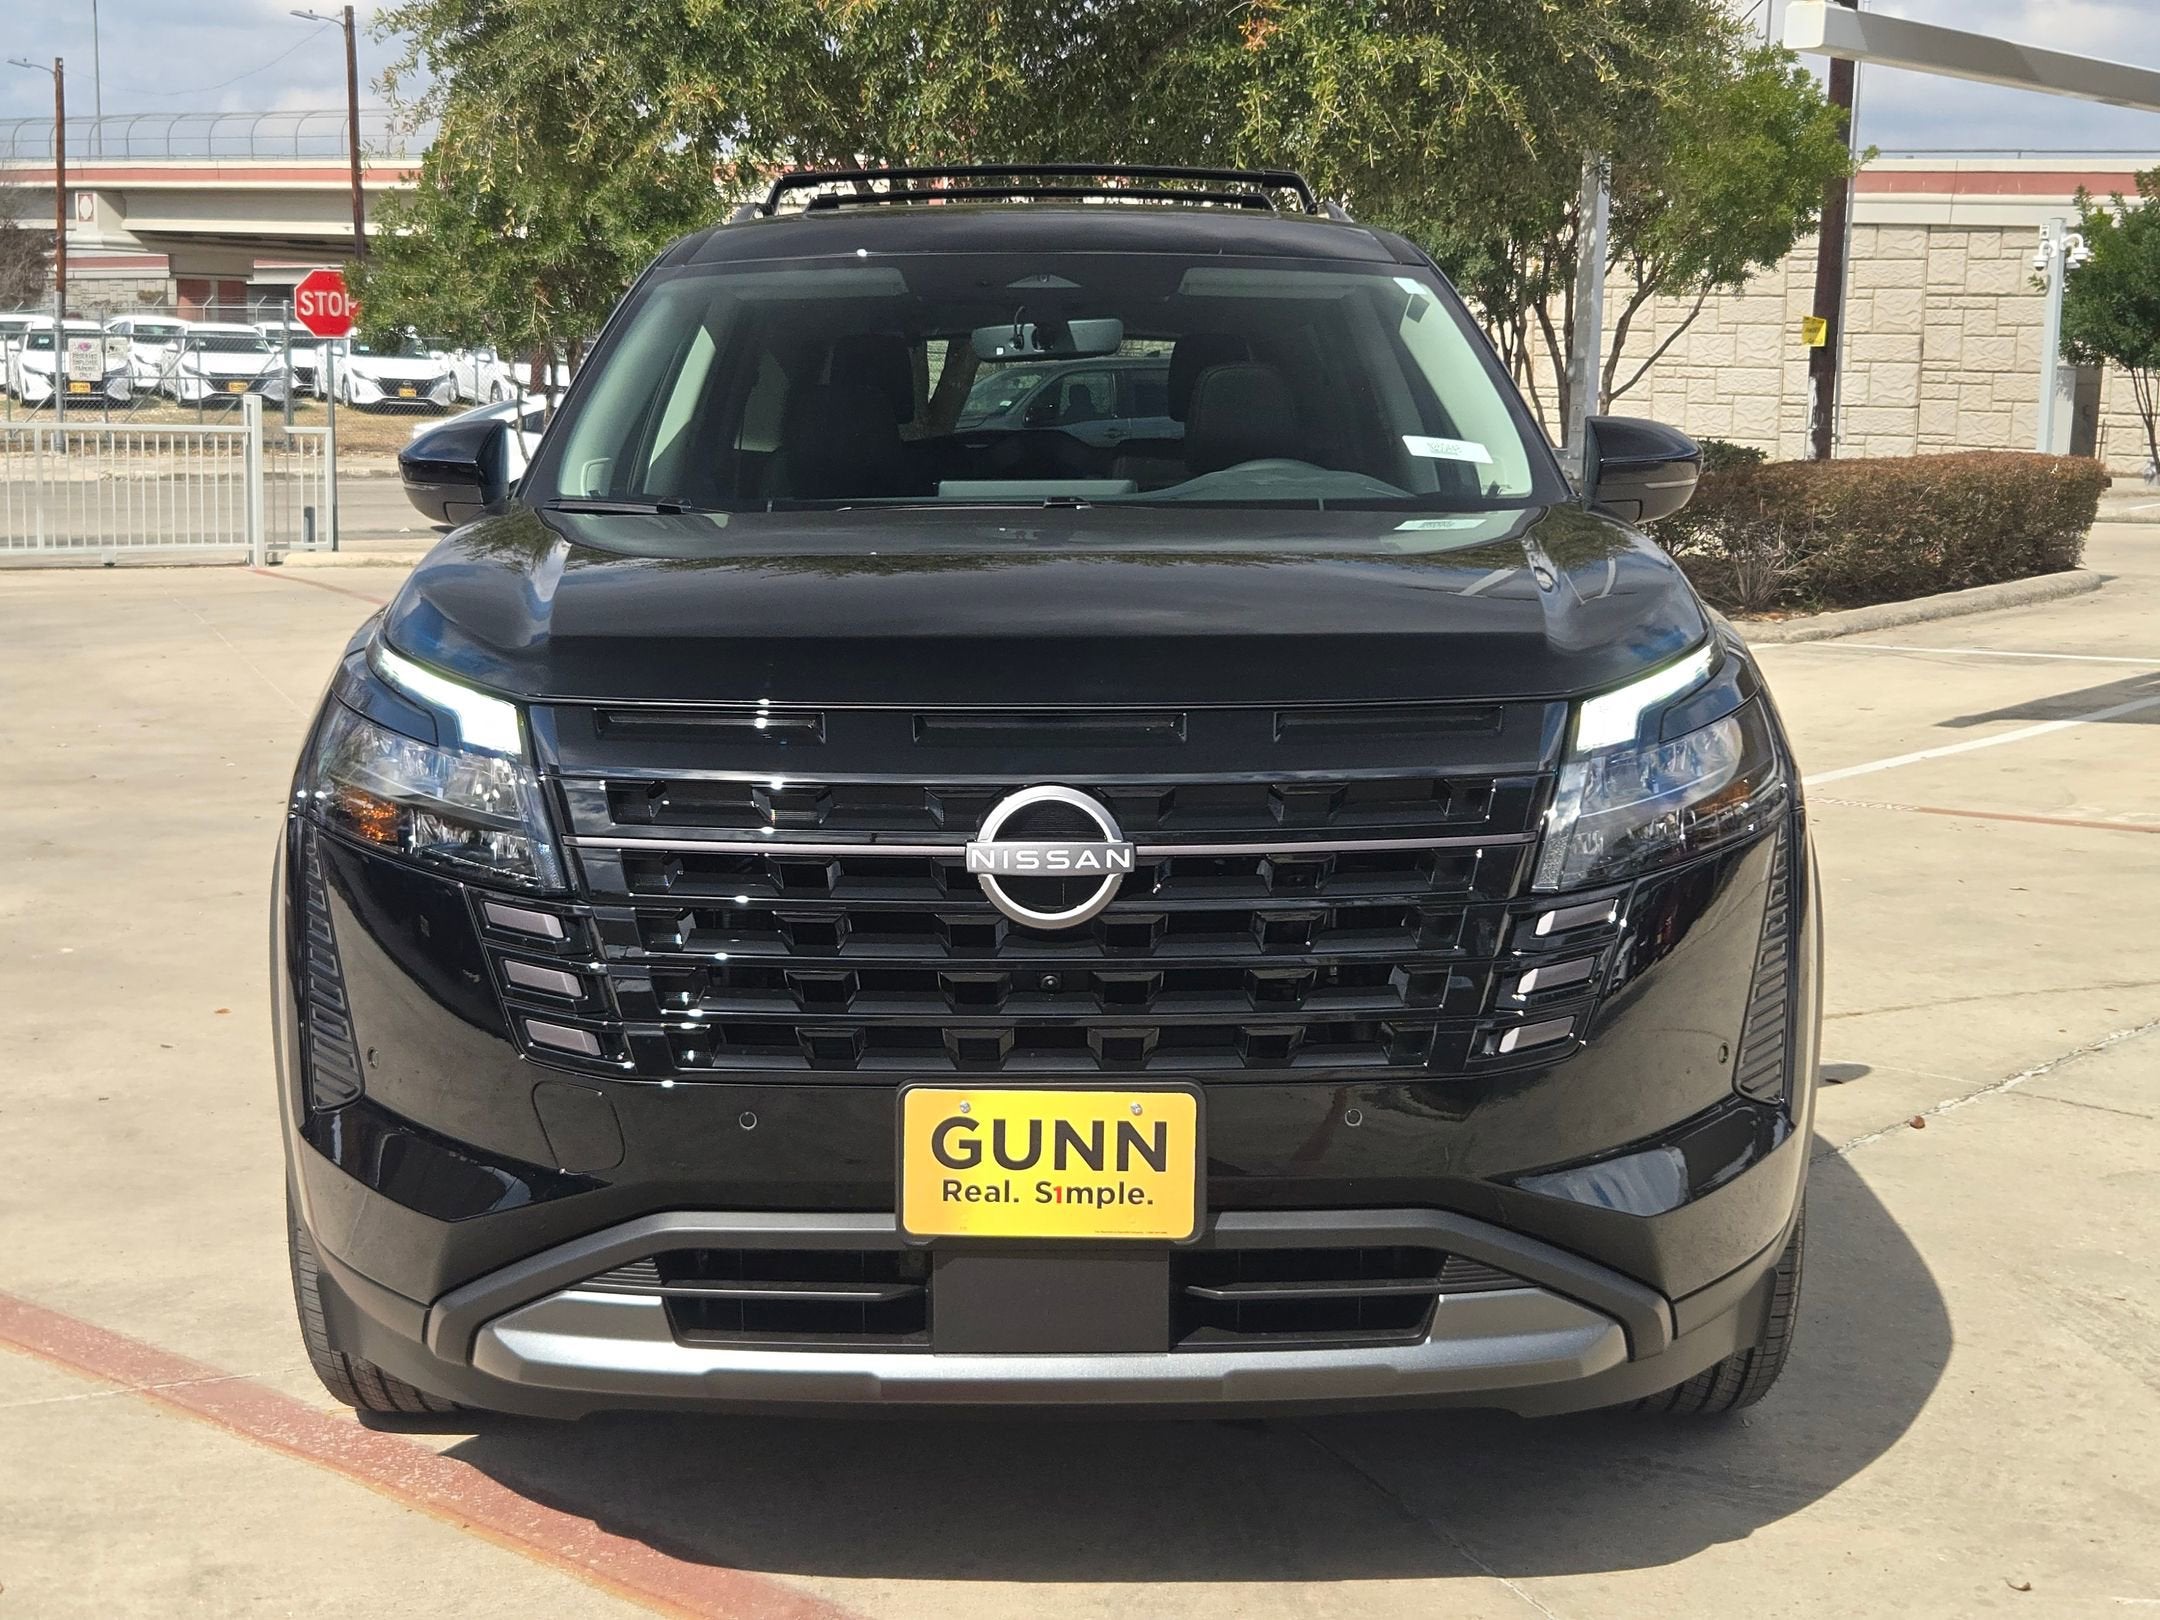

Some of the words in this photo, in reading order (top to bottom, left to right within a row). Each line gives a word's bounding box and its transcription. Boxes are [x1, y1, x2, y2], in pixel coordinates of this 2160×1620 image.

[971, 848, 1131, 869] NISSAN
[931, 1116, 1168, 1173] GUNN
[942, 1179, 1020, 1203] Real.
